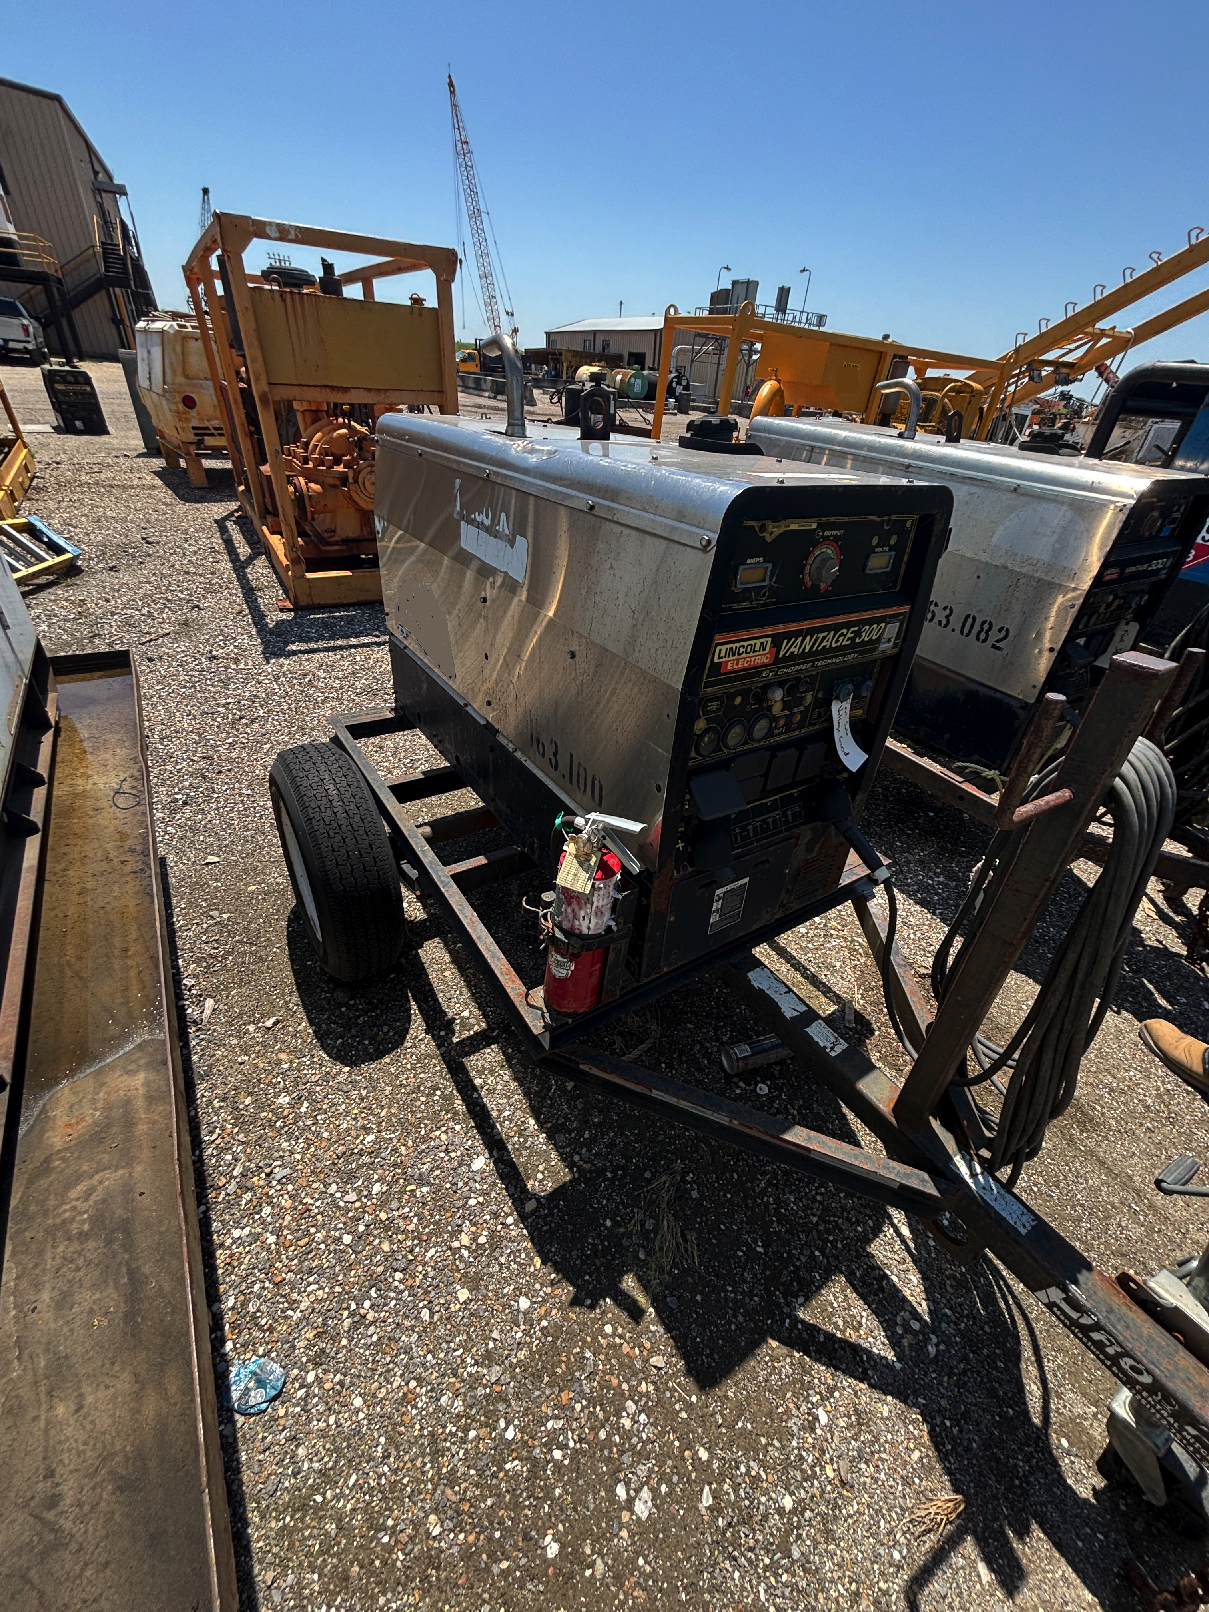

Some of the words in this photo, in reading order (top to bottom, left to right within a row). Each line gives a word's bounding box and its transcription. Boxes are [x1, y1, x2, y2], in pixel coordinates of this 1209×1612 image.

[717, 639, 770, 661] LINCOLN
[779, 626, 861, 658] VANTAGE
[856, 623, 885, 643] 300
[727, 654, 770, 670] ELECTRIC
[778, 663, 813, 675] CHOPPER
[814, 653, 860, 667] TECHNOLOGY
[1053, 1306, 1111, 1365] Manfactured
[1136, 1385, 1180, 1430] CENTRAL
